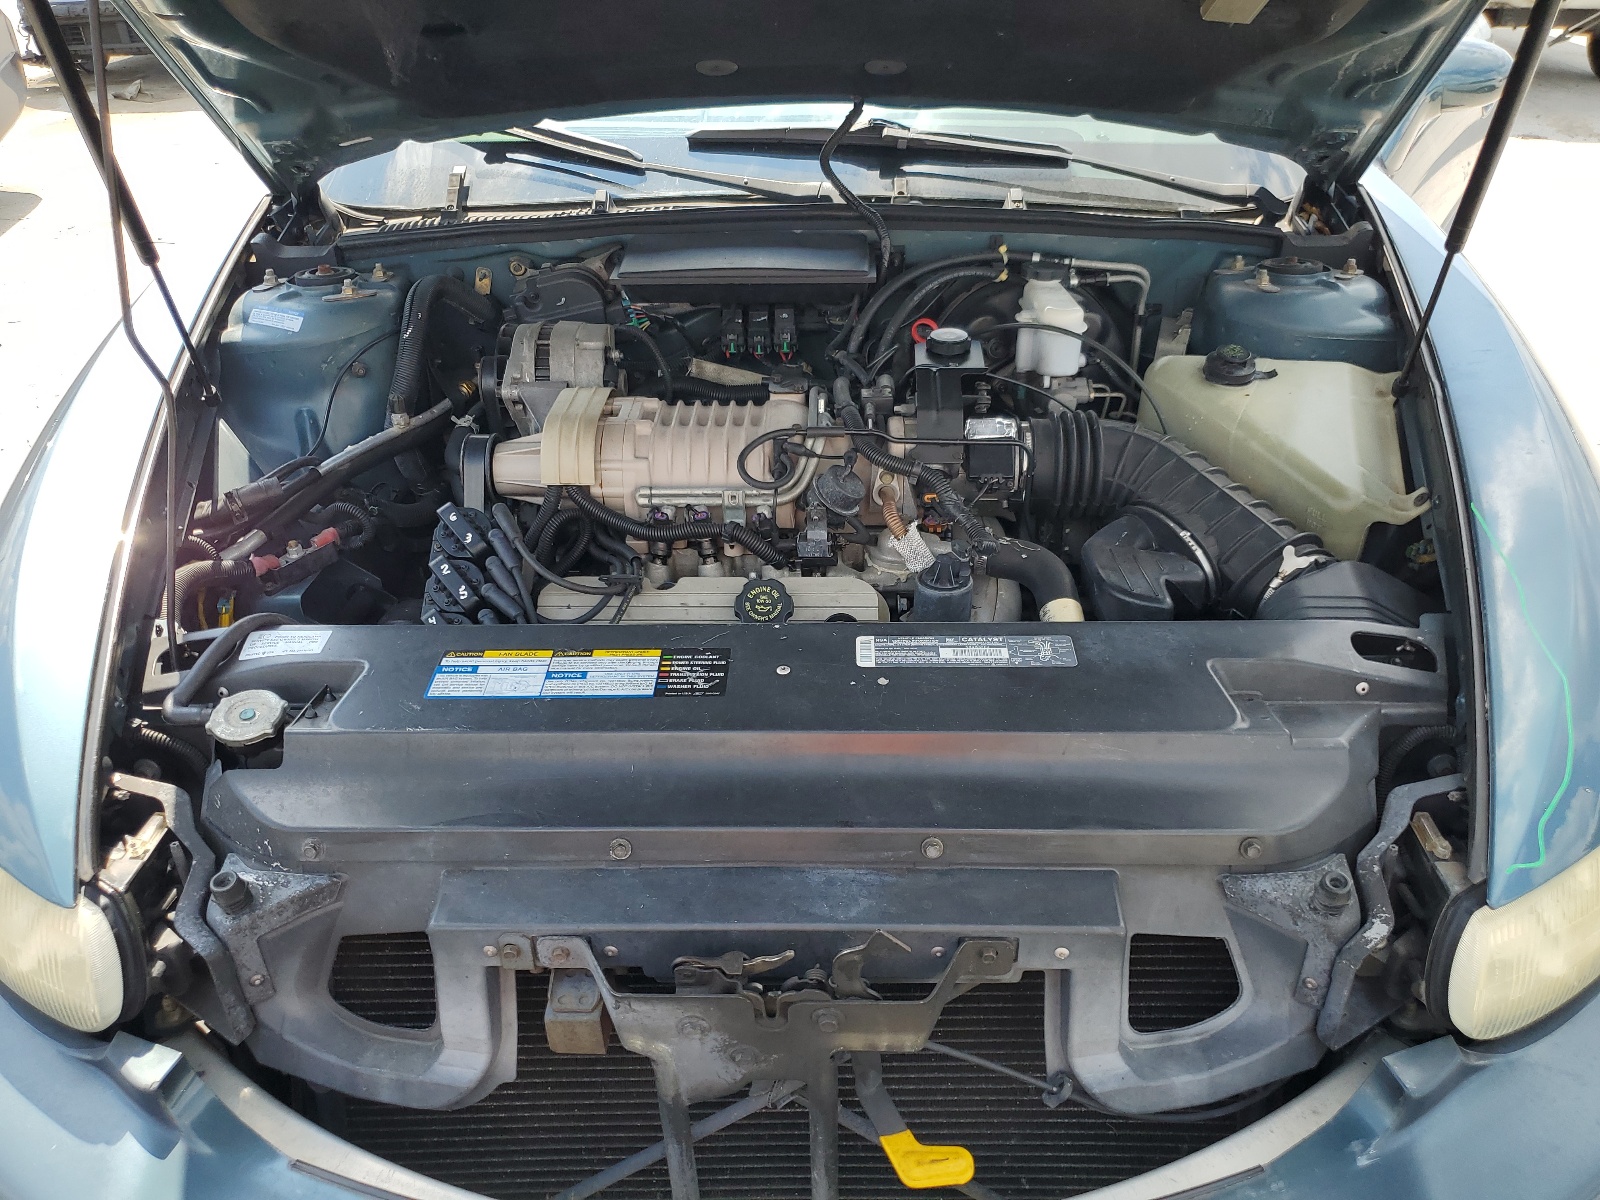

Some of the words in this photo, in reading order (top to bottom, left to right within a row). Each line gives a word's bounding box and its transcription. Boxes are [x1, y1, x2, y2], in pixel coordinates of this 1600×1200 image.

[449, 512, 458, 521] 6
[464, 533, 473, 543] 3
[440, 564, 451, 575] 2
[747, 586, 772, 599] ENGINE
